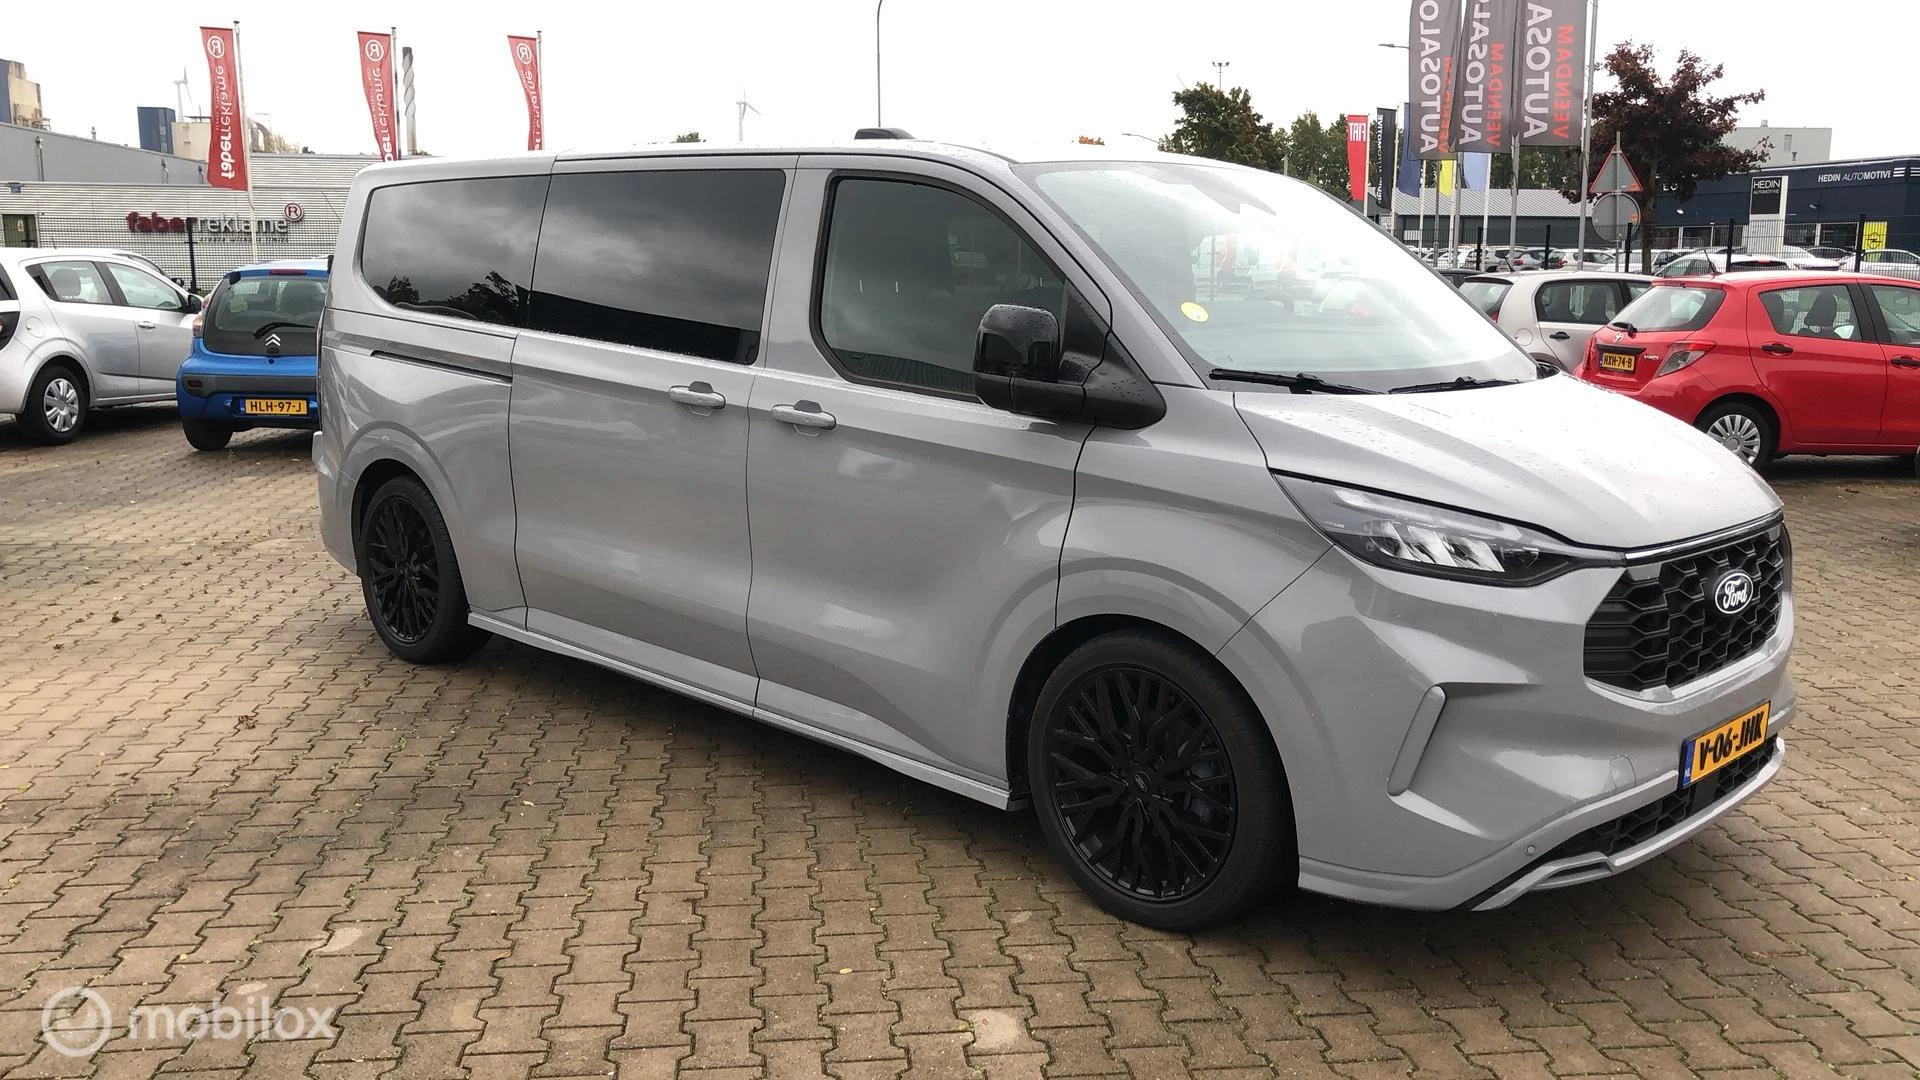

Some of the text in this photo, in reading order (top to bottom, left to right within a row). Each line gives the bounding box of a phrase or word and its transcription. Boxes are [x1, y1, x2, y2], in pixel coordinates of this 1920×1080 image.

[1817, 173, 1841, 182] HEDIN
[1754, 180, 1780, 189] HEDIN
[1603, 354, 1632, 368] HXH-74-B
[250, 401, 302, 412] HLH-97-J
[1723, 579, 1748, 609] Ford
[1699, 711, 1765, 770] V-06-JHK
